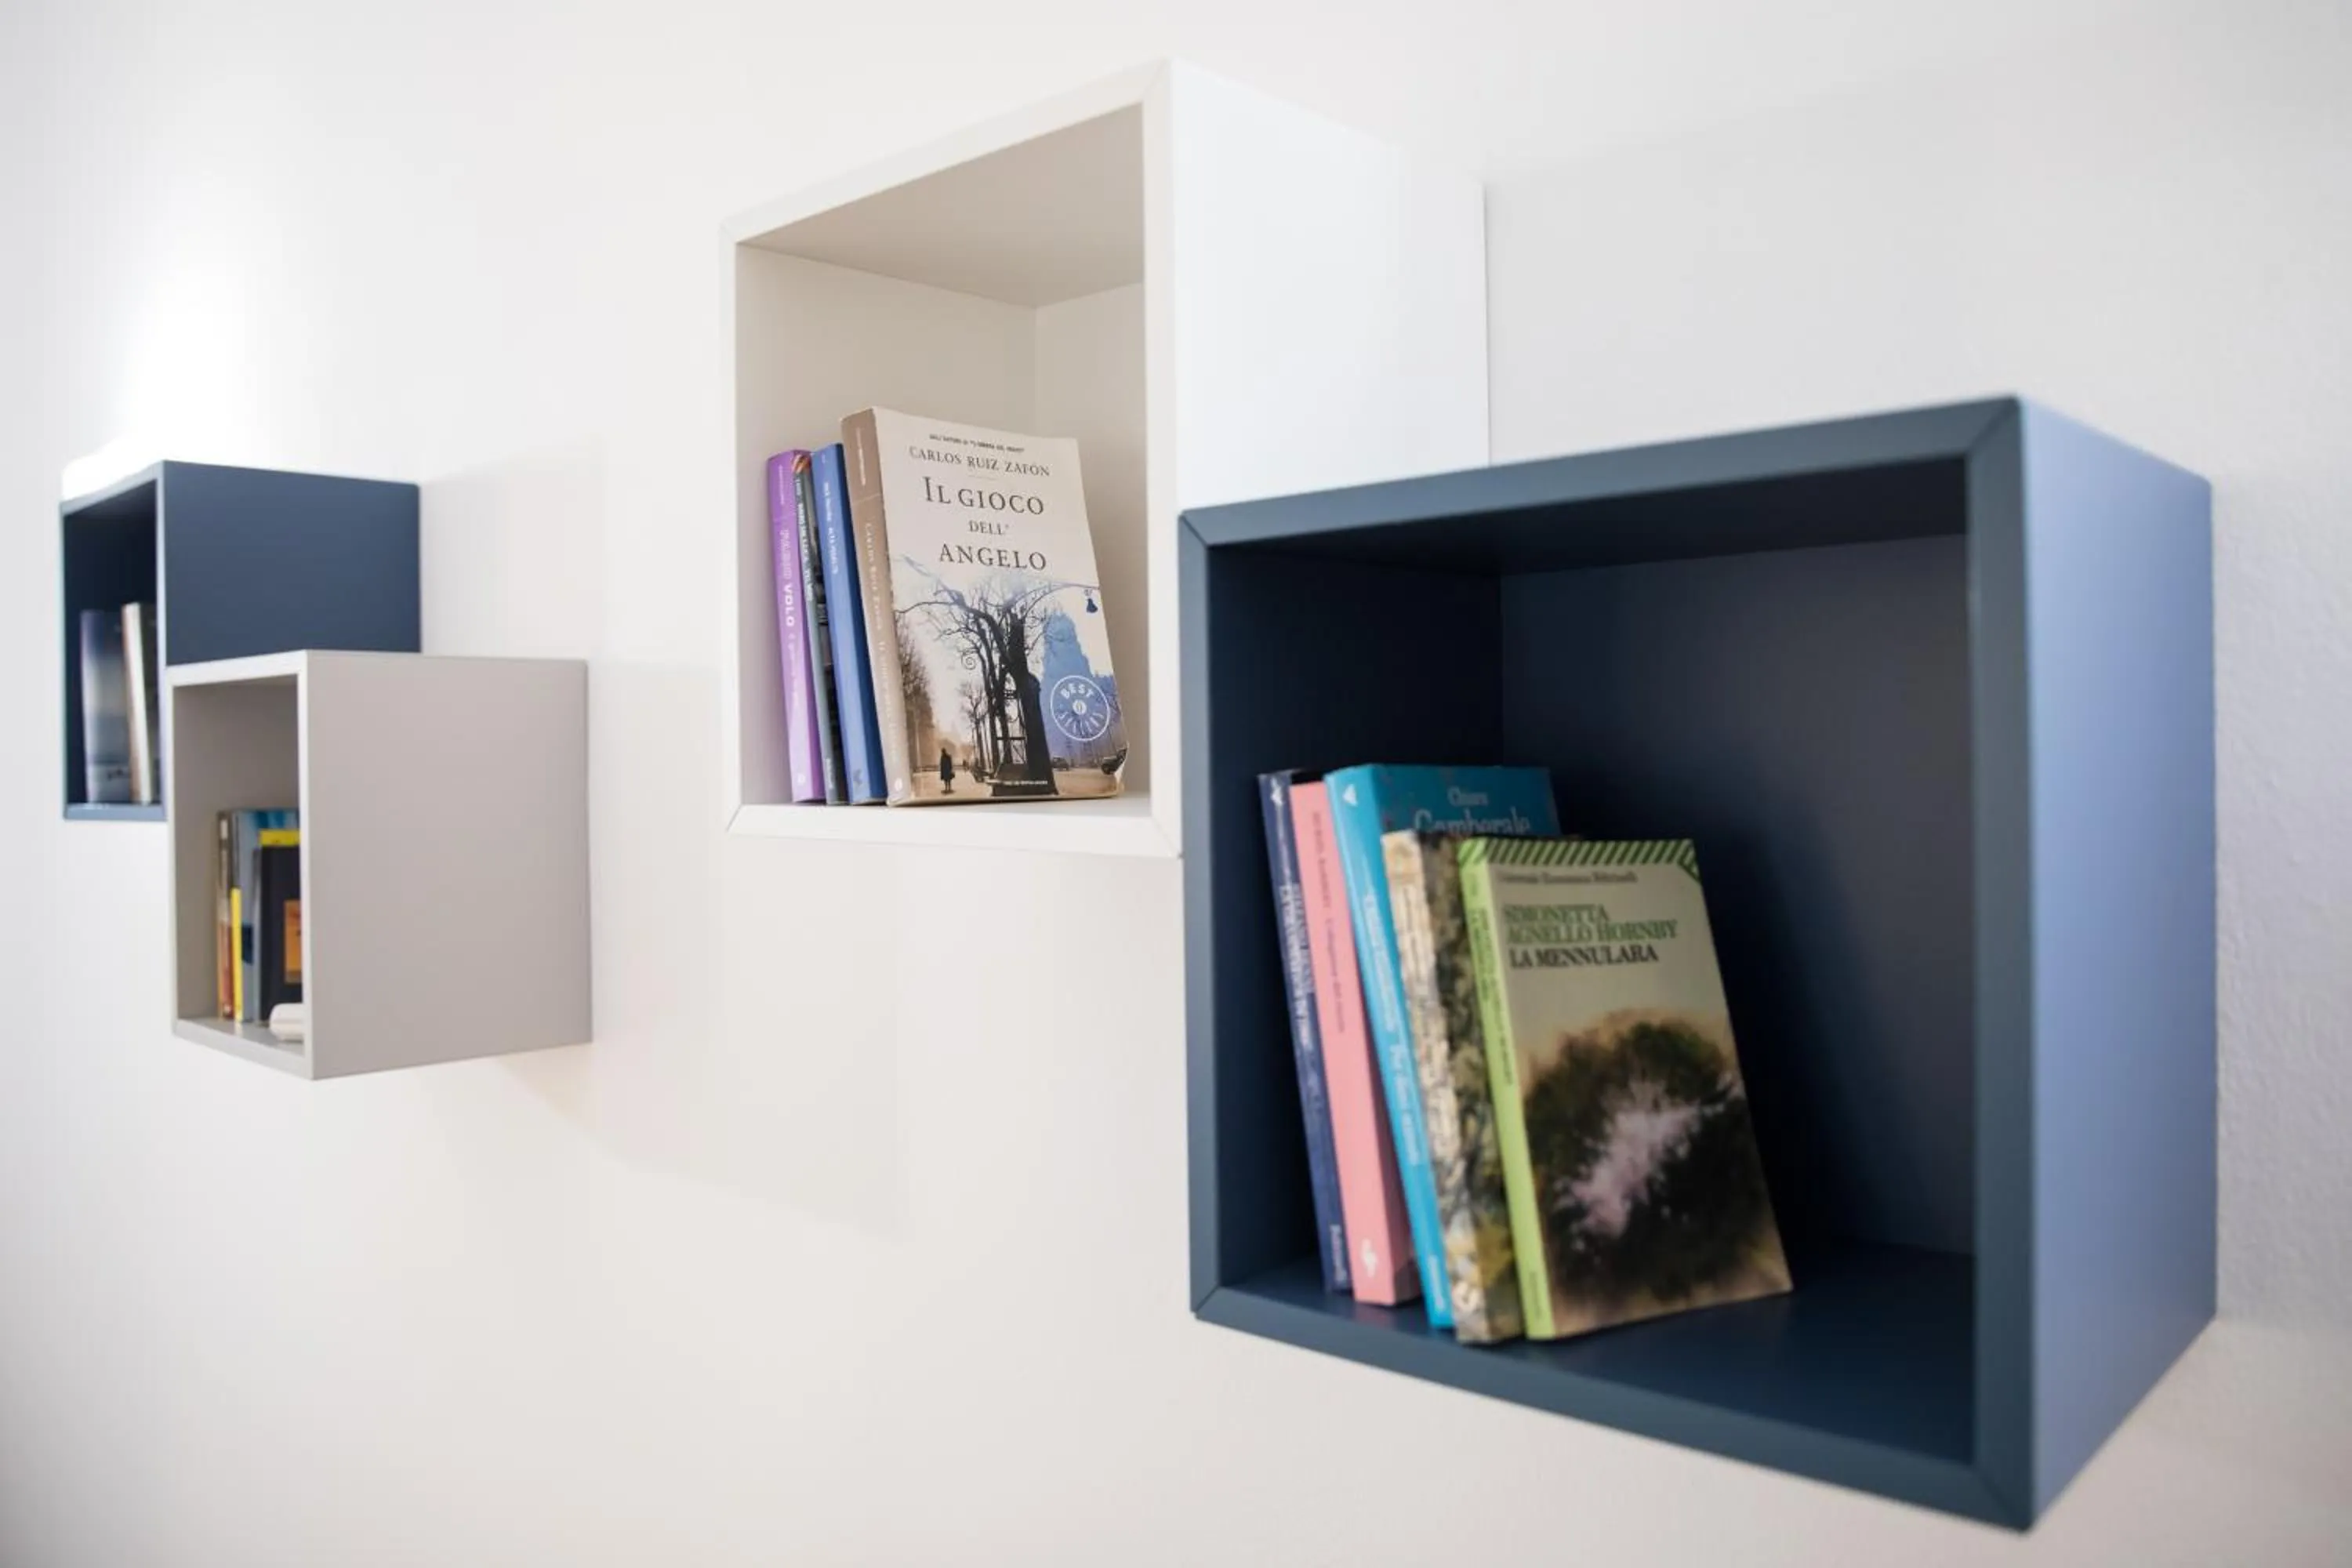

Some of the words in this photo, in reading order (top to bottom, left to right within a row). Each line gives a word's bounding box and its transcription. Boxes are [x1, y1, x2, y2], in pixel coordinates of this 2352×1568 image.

[909, 445, 962, 464] CARLOS
[966, 455, 1000, 470] RUIZ
[922, 476, 951, 504] IL
[957, 488, 1044, 515] GIOCO
[940, 543, 1047, 571] ANGELO
[1060, 683, 1094, 700] BEST
[1506, 922, 1594, 944] AGNELLO
[1598, 918, 1678, 941] HORNBY
[1508, 948, 1533, 968] LA
